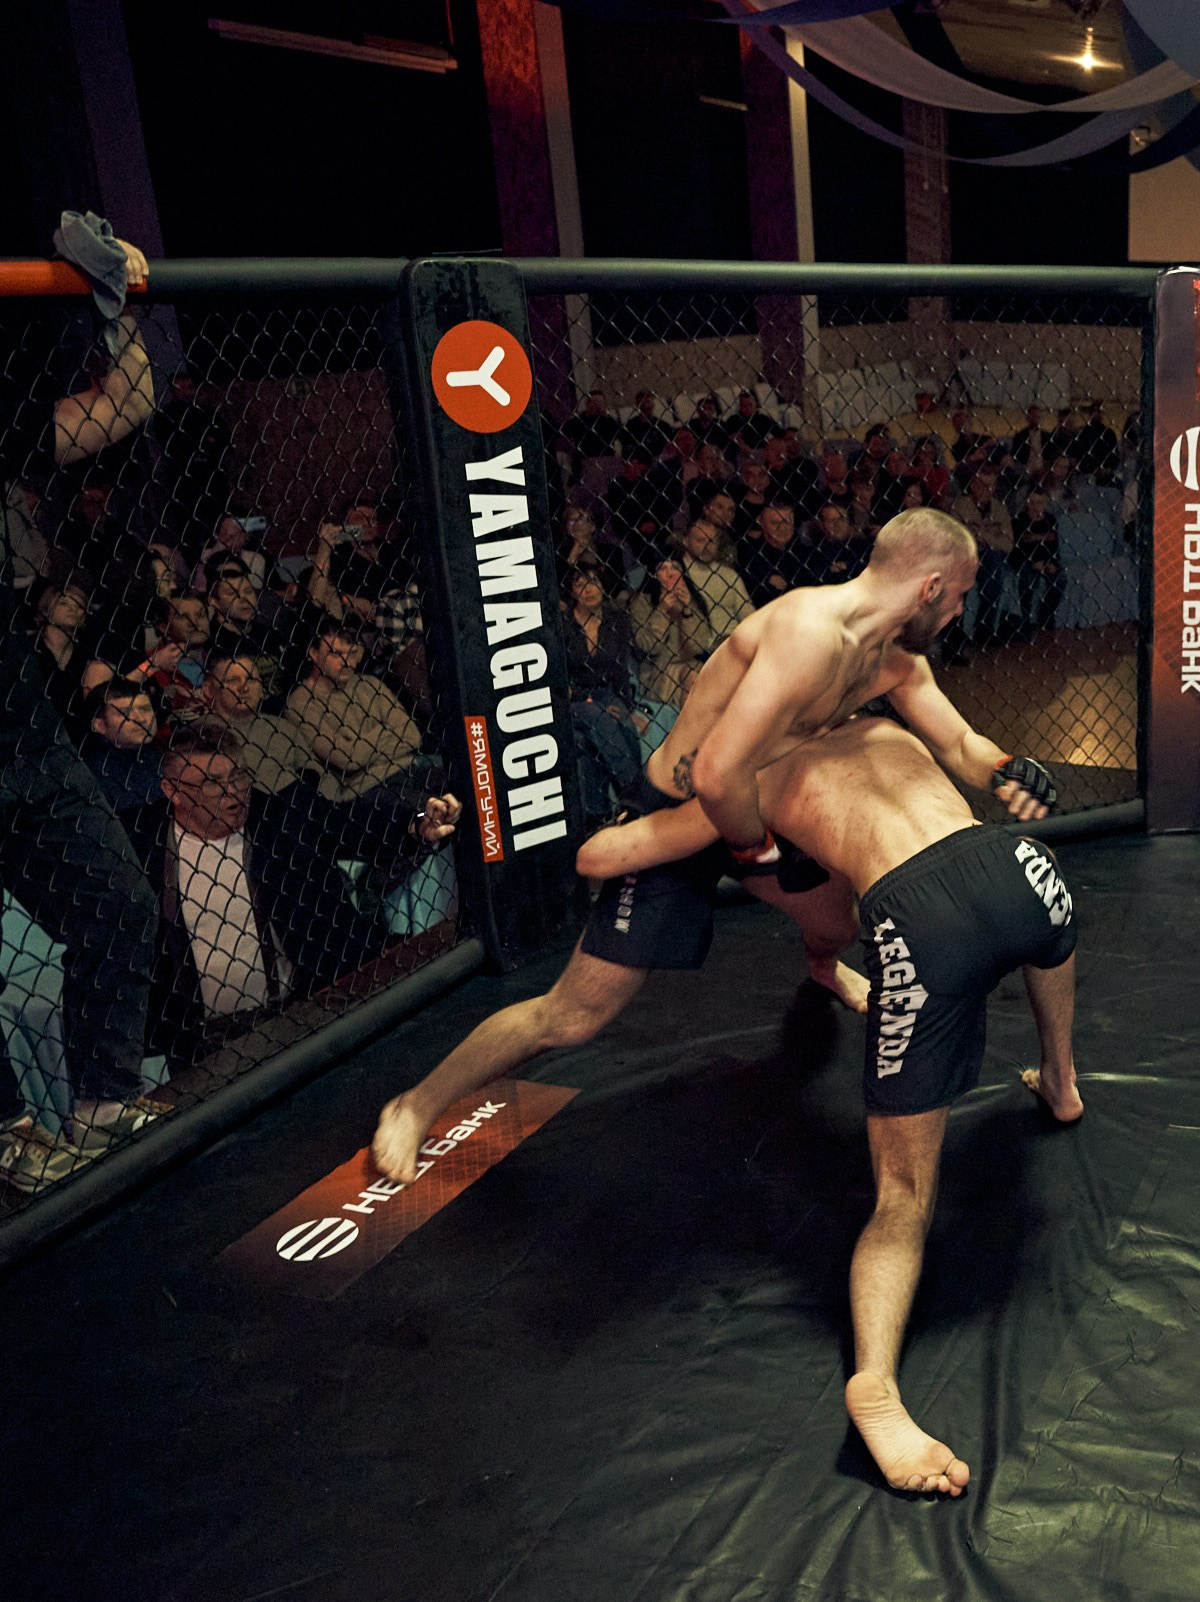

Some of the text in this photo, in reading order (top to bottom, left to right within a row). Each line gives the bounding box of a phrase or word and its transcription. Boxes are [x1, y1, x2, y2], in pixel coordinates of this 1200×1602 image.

[464, 445, 568, 852] YAMAGUCHI
[470, 722, 502, 857] #ЯМОГУЧИЙ
[873, 916, 929, 1079] LEGENDA
[420, 1101, 507, 1156] Банк
